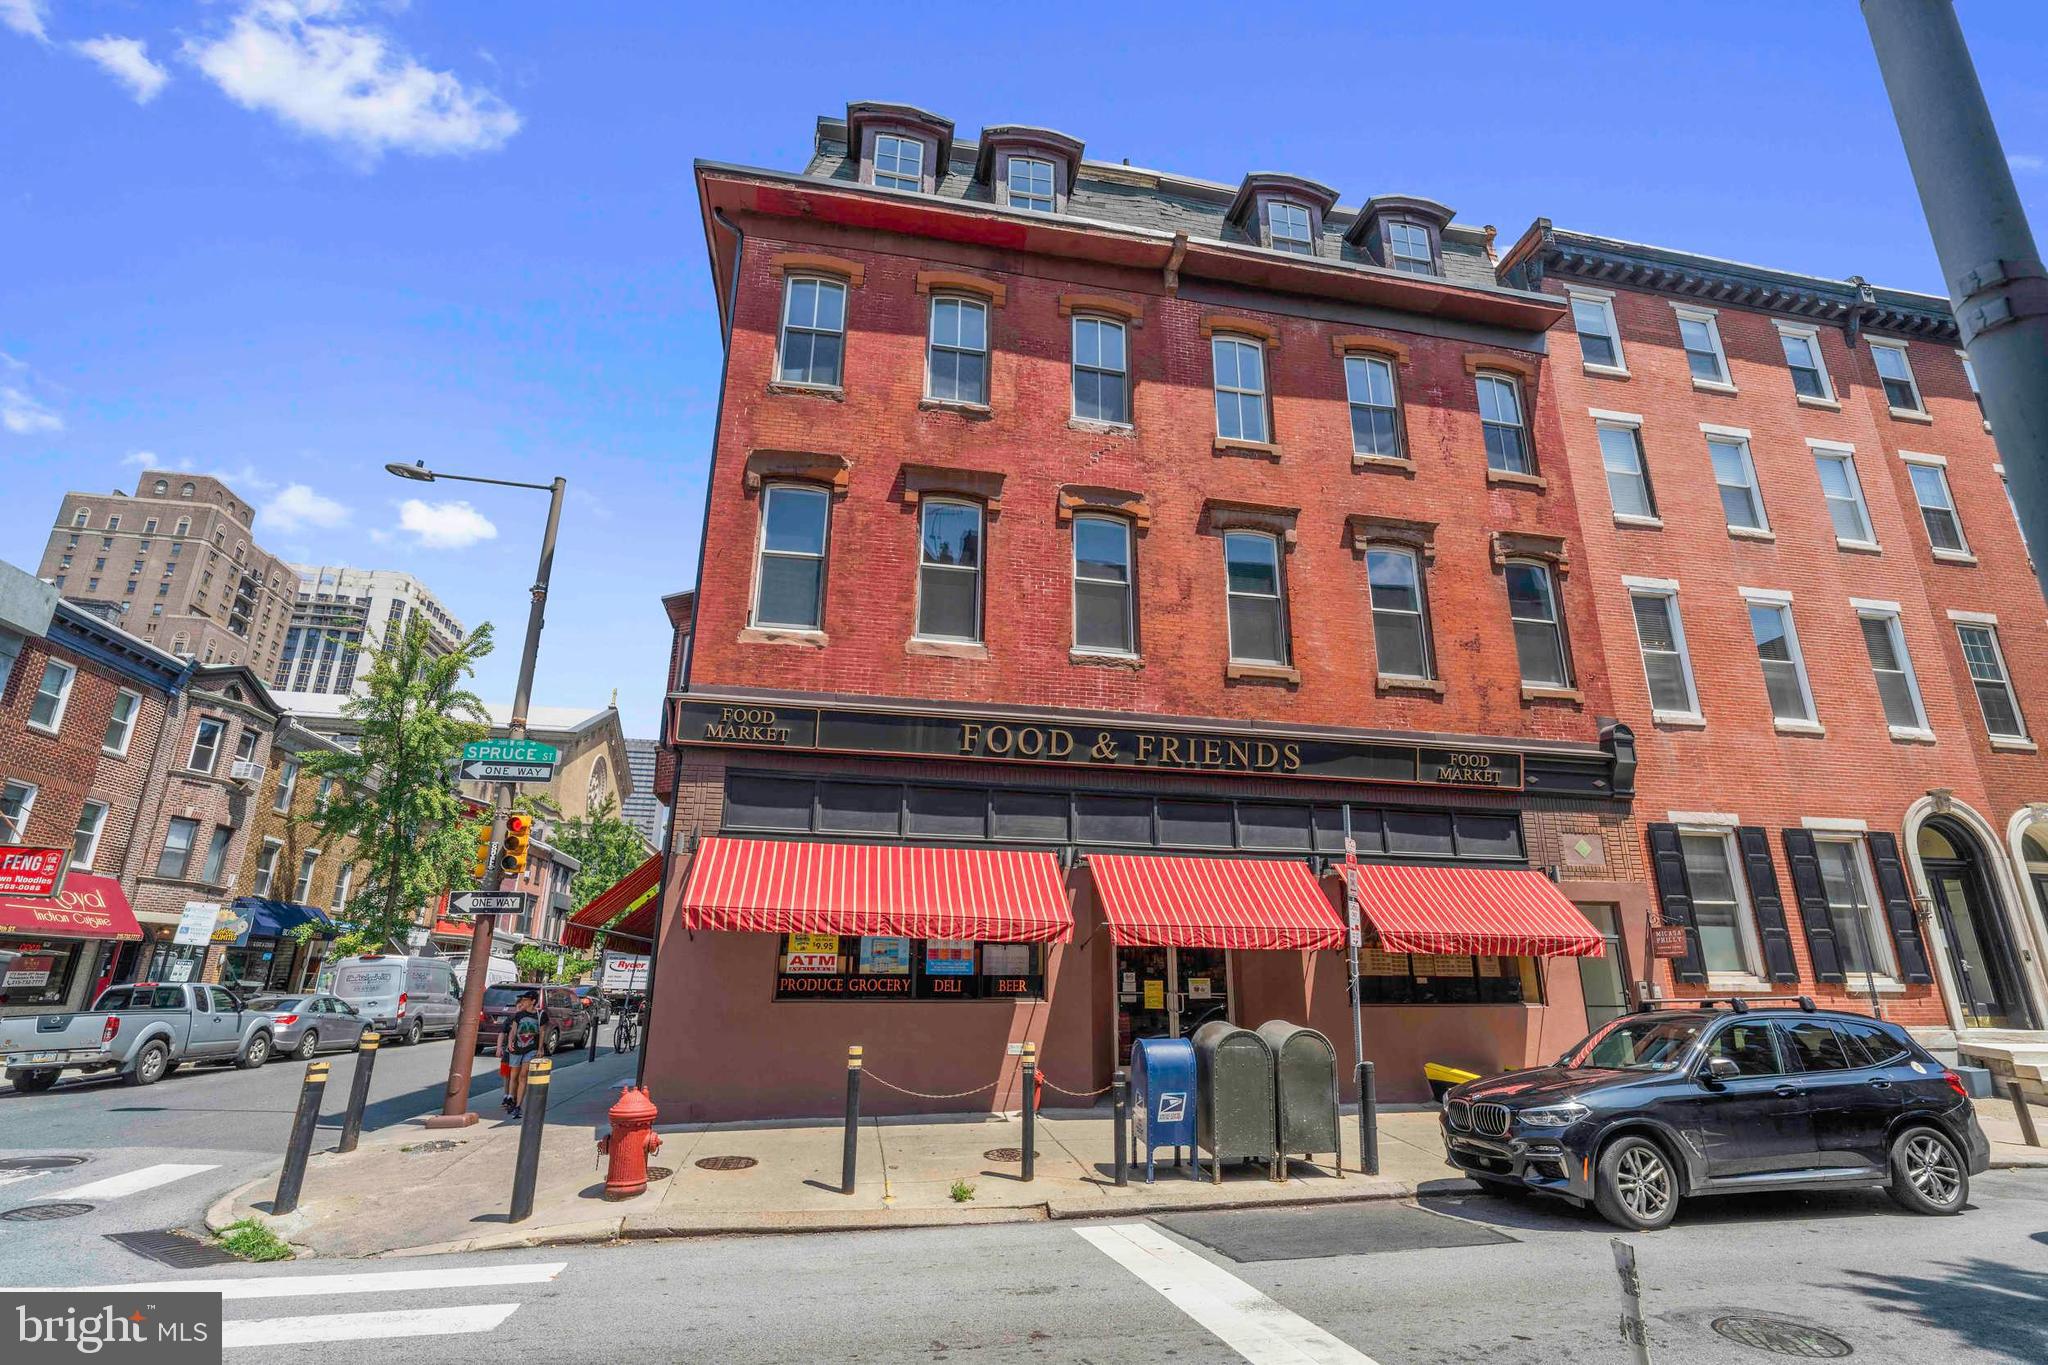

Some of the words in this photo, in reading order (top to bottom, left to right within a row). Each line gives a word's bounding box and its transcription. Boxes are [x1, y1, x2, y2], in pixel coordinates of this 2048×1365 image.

[722, 707, 775, 724] FOOD
[705, 723, 791, 742] MARKET
[467, 746, 538, 761] SPRUCE
[542, 752, 554, 761] ST
[960, 723, 1074, 757] FOOD
[1091, 732, 1118, 760] &
[1135, 734, 1300, 770] FRIENDS
[1449, 753, 1490, 768] FOOD
[485, 766, 510, 775] ONE
[517, 767, 542, 777] WAY
[1439, 767, 1501, 783] MARKET
[3, 854, 42, 872] FENG
[15, 875, 52, 885] Noodles
[471, 898, 492, 907] ONE
[496, 898, 516, 907] WAY
[34, 909, 69, 923] Indian
[73, 912, 112, 929] Cuisine
[617, 960, 646, 969] Ryder
[789, 955, 836, 966] ATM
[780, 978, 844, 992] PRODUCE
[848, 979, 911, 992] GROCERY
[933, 979, 963, 993] DELI
[997, 979, 1028, 992] BEER
